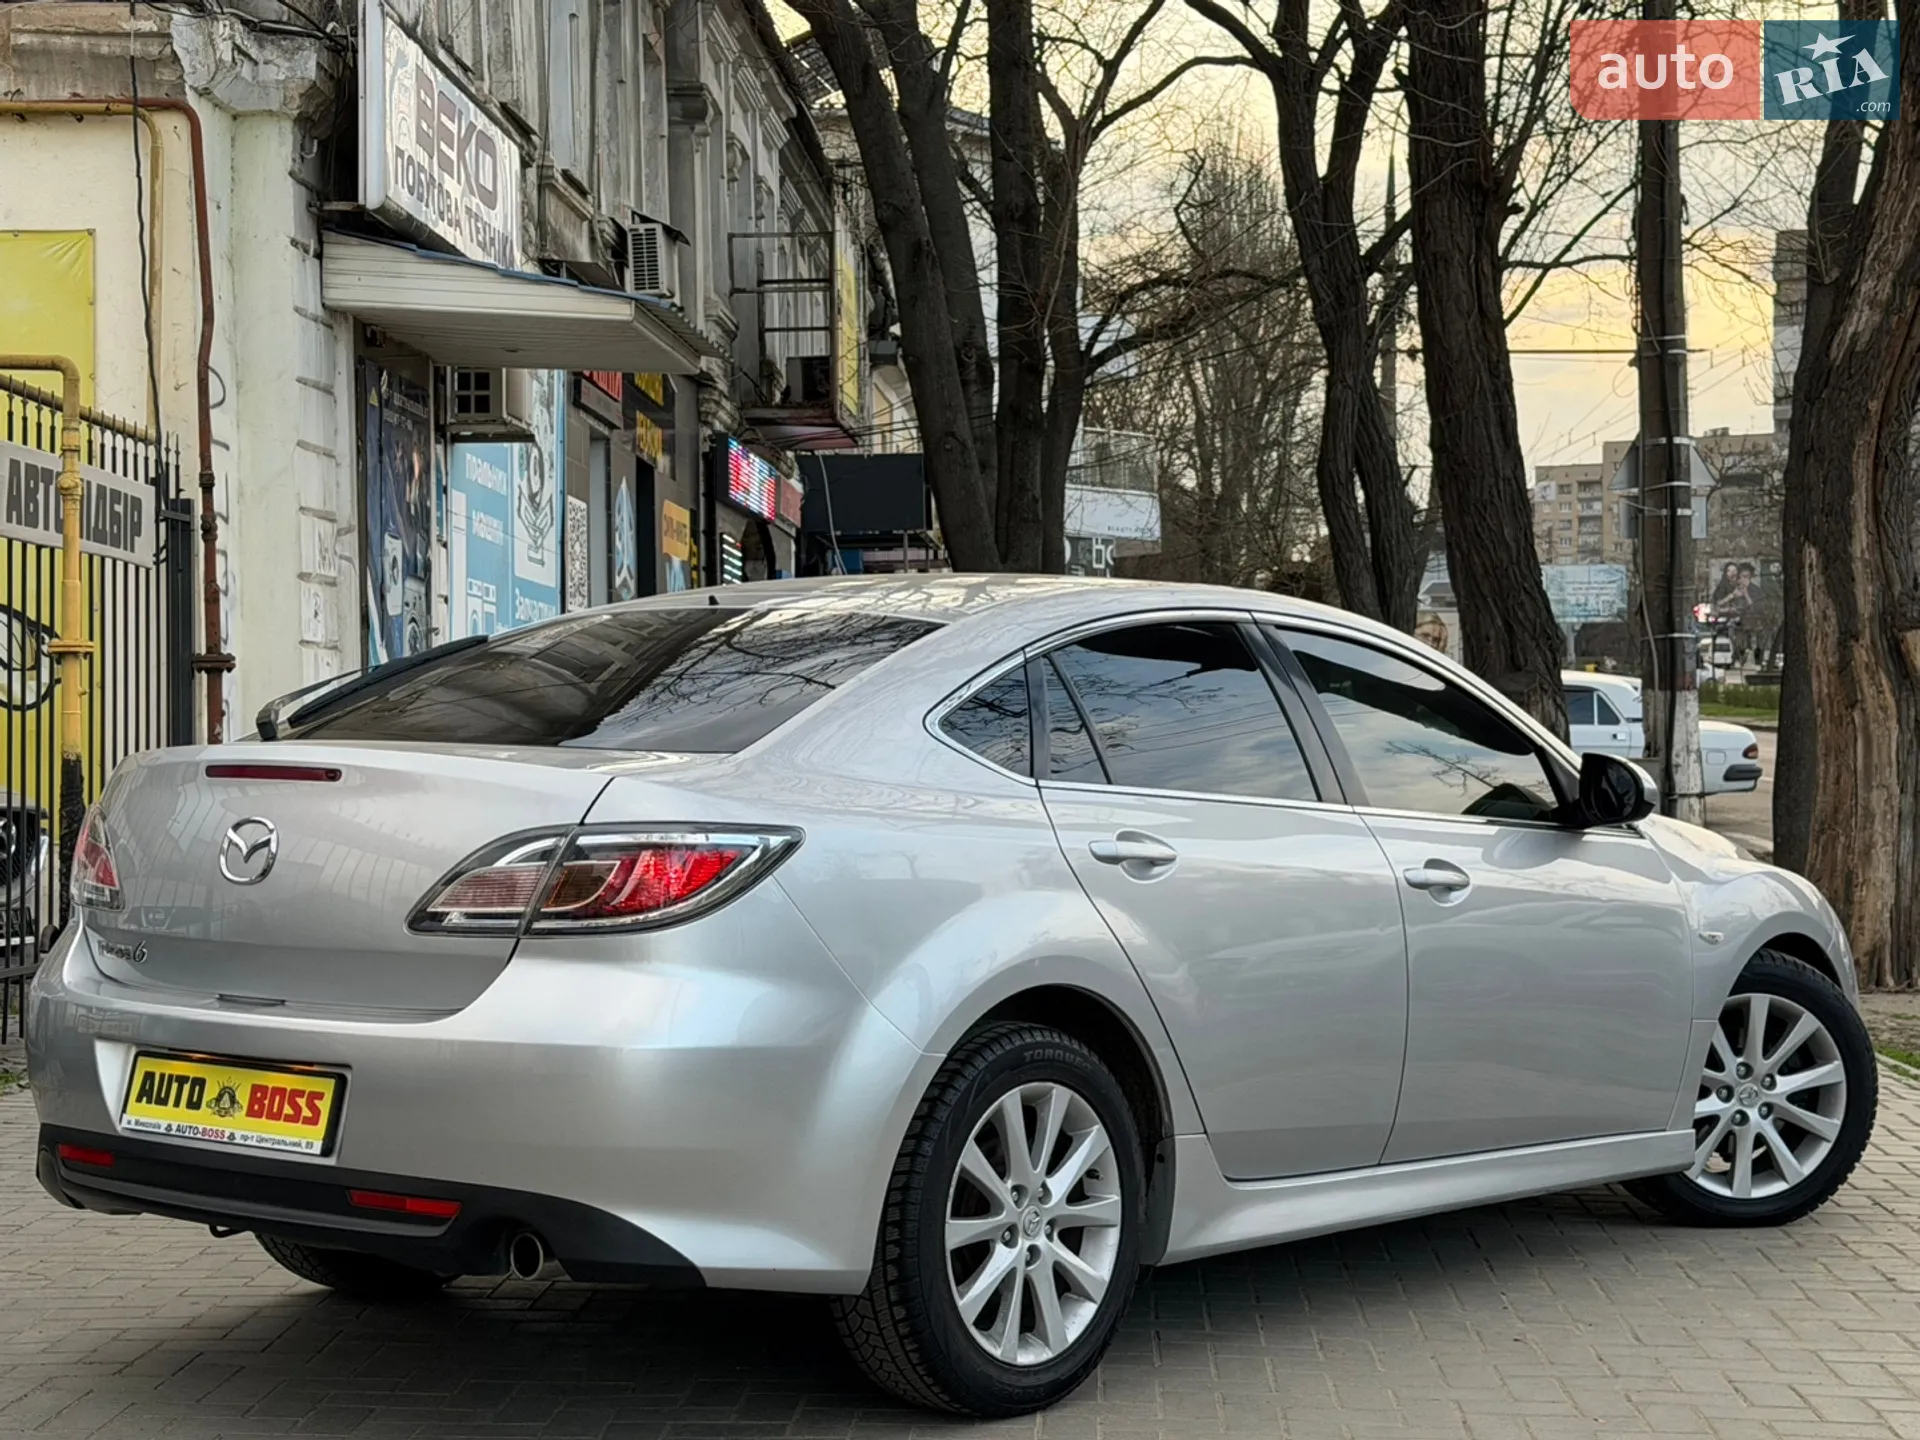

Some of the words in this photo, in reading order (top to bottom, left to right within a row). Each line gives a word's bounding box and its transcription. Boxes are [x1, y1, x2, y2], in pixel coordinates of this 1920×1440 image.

[416, 62, 497, 211] BEKO
[395, 146, 463, 237] ПОБУТОВА
[465, 205, 515, 270] ТЕХНІКА
[6, 457, 142, 554] АВТІДБІР
[135, 1070, 207, 1111] AUTO
[245, 1083, 325, 1126] BOSS
[174, 1123, 226, 1140] AUTO-BOSS
